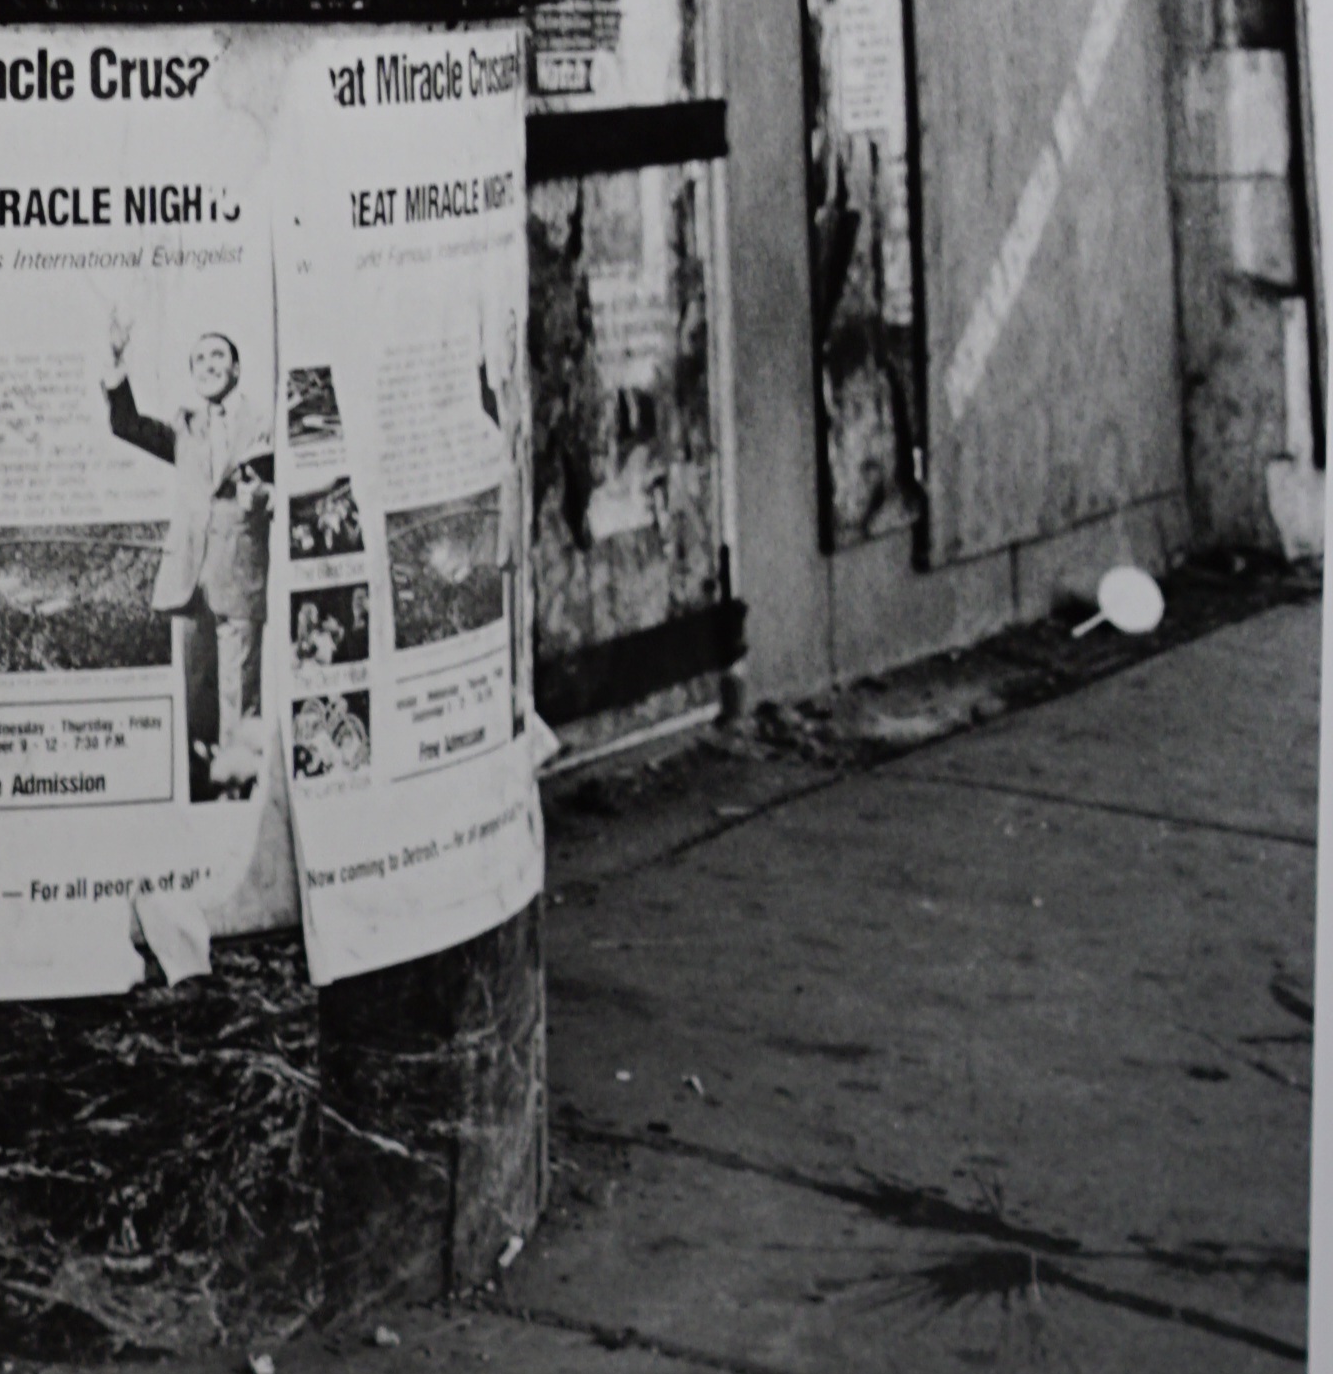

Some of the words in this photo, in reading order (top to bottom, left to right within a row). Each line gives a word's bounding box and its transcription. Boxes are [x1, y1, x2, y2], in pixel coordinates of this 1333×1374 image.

[376, 51, 463, 104] Miracle
[405, 177, 479, 223] MIRACLE
[13, 247, 143, 270] International
[151, 243, 244, 270] Evangelist
[61, 717, 113, 734] Thursday
[129, 714, 162, 731] Friday
[45, 737, 57, 752] 12
[12, 772, 106, 797] Admission
[307, 868, 334, 889] Now
[341, 857, 385, 881] coming
[389, 851, 399, 870] to
[30, 879, 59, 902] For
[65, 876, 87, 900] all
[158, 869, 175, 892] of
